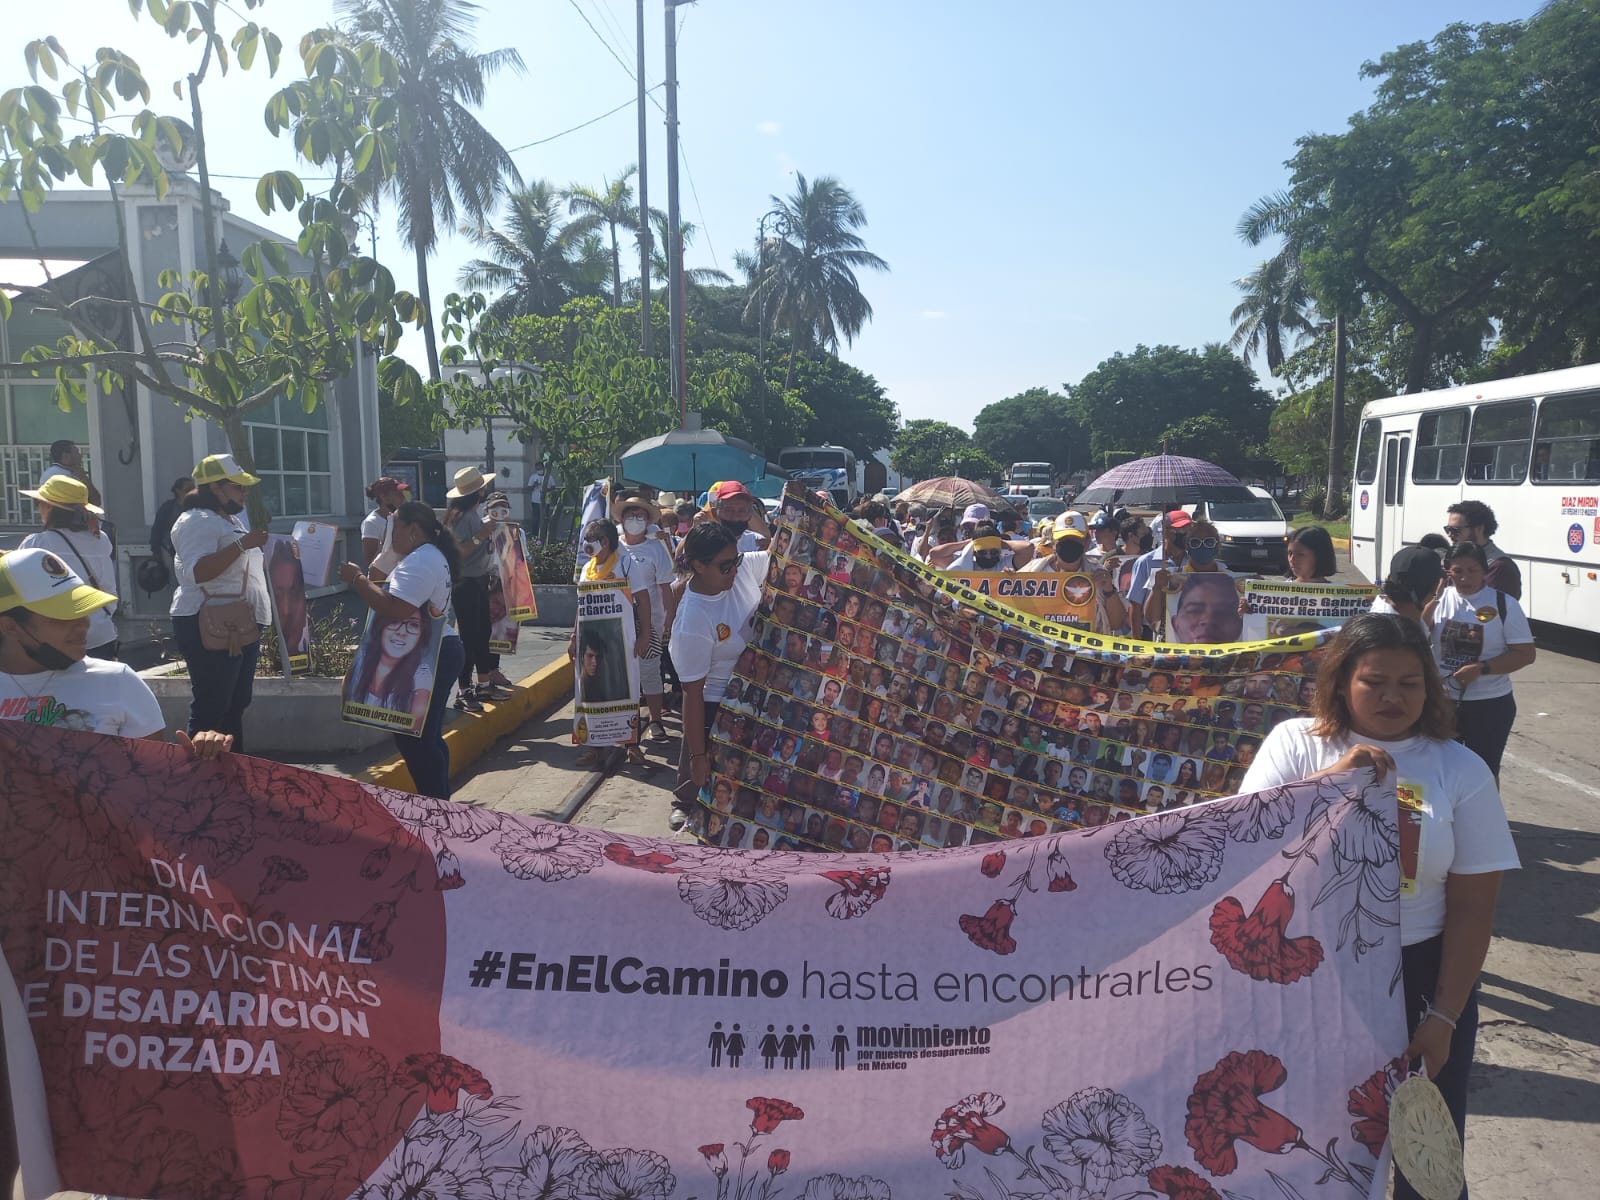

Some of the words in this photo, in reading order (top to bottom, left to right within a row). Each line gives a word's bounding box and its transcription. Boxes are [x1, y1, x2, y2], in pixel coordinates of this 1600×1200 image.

[1562, 497, 1576, 507] DIAZ
[1578, 497, 1598, 507] MIRON
[977, 579, 991, 596] A
[998, 579, 1058, 597] CASA!
[1252, 583, 1290, 592] COLECTIVO
[1291, 585, 1325, 595] SOLECITO
[1326, 587, 1336, 595] DE
[586, 593, 616, 605] Omar
[1247, 593, 1317, 607] Praxedes
[1320, 597, 1372, 608] Gabrie
[1044, 612, 1079, 623] FABIÁN
[1250, 604, 1295, 616] Gómez
[1298, 606, 1370, 617] Hernánde
[1113, 642, 1144, 653] DE
[150, 853, 214, 899] DÍA
[46, 889, 373, 965] INTERNACIONAL
[45, 937, 99, 974] DE
[111, 941, 192, 978] LAS
[202, 944, 382, 1007] VÍCTIMAS
[468, 951, 789, 998] #EnElCamino
[802, 960, 918, 1001] hasta
[933, 961, 1214, 1003] encontrarles
[62, 983, 370, 1038] DESAPARICIÓN
[857, 1023, 991, 1048] movimiento
[84, 1031, 281, 1076] FORZADA
[857, 1050, 873, 1060] por
[875, 1049, 918, 1059] nuestros
[920, 1046, 991, 1058] desaparecidos
[857, 1063, 869, 1071] en
[872, 1061, 907, 1071] México
